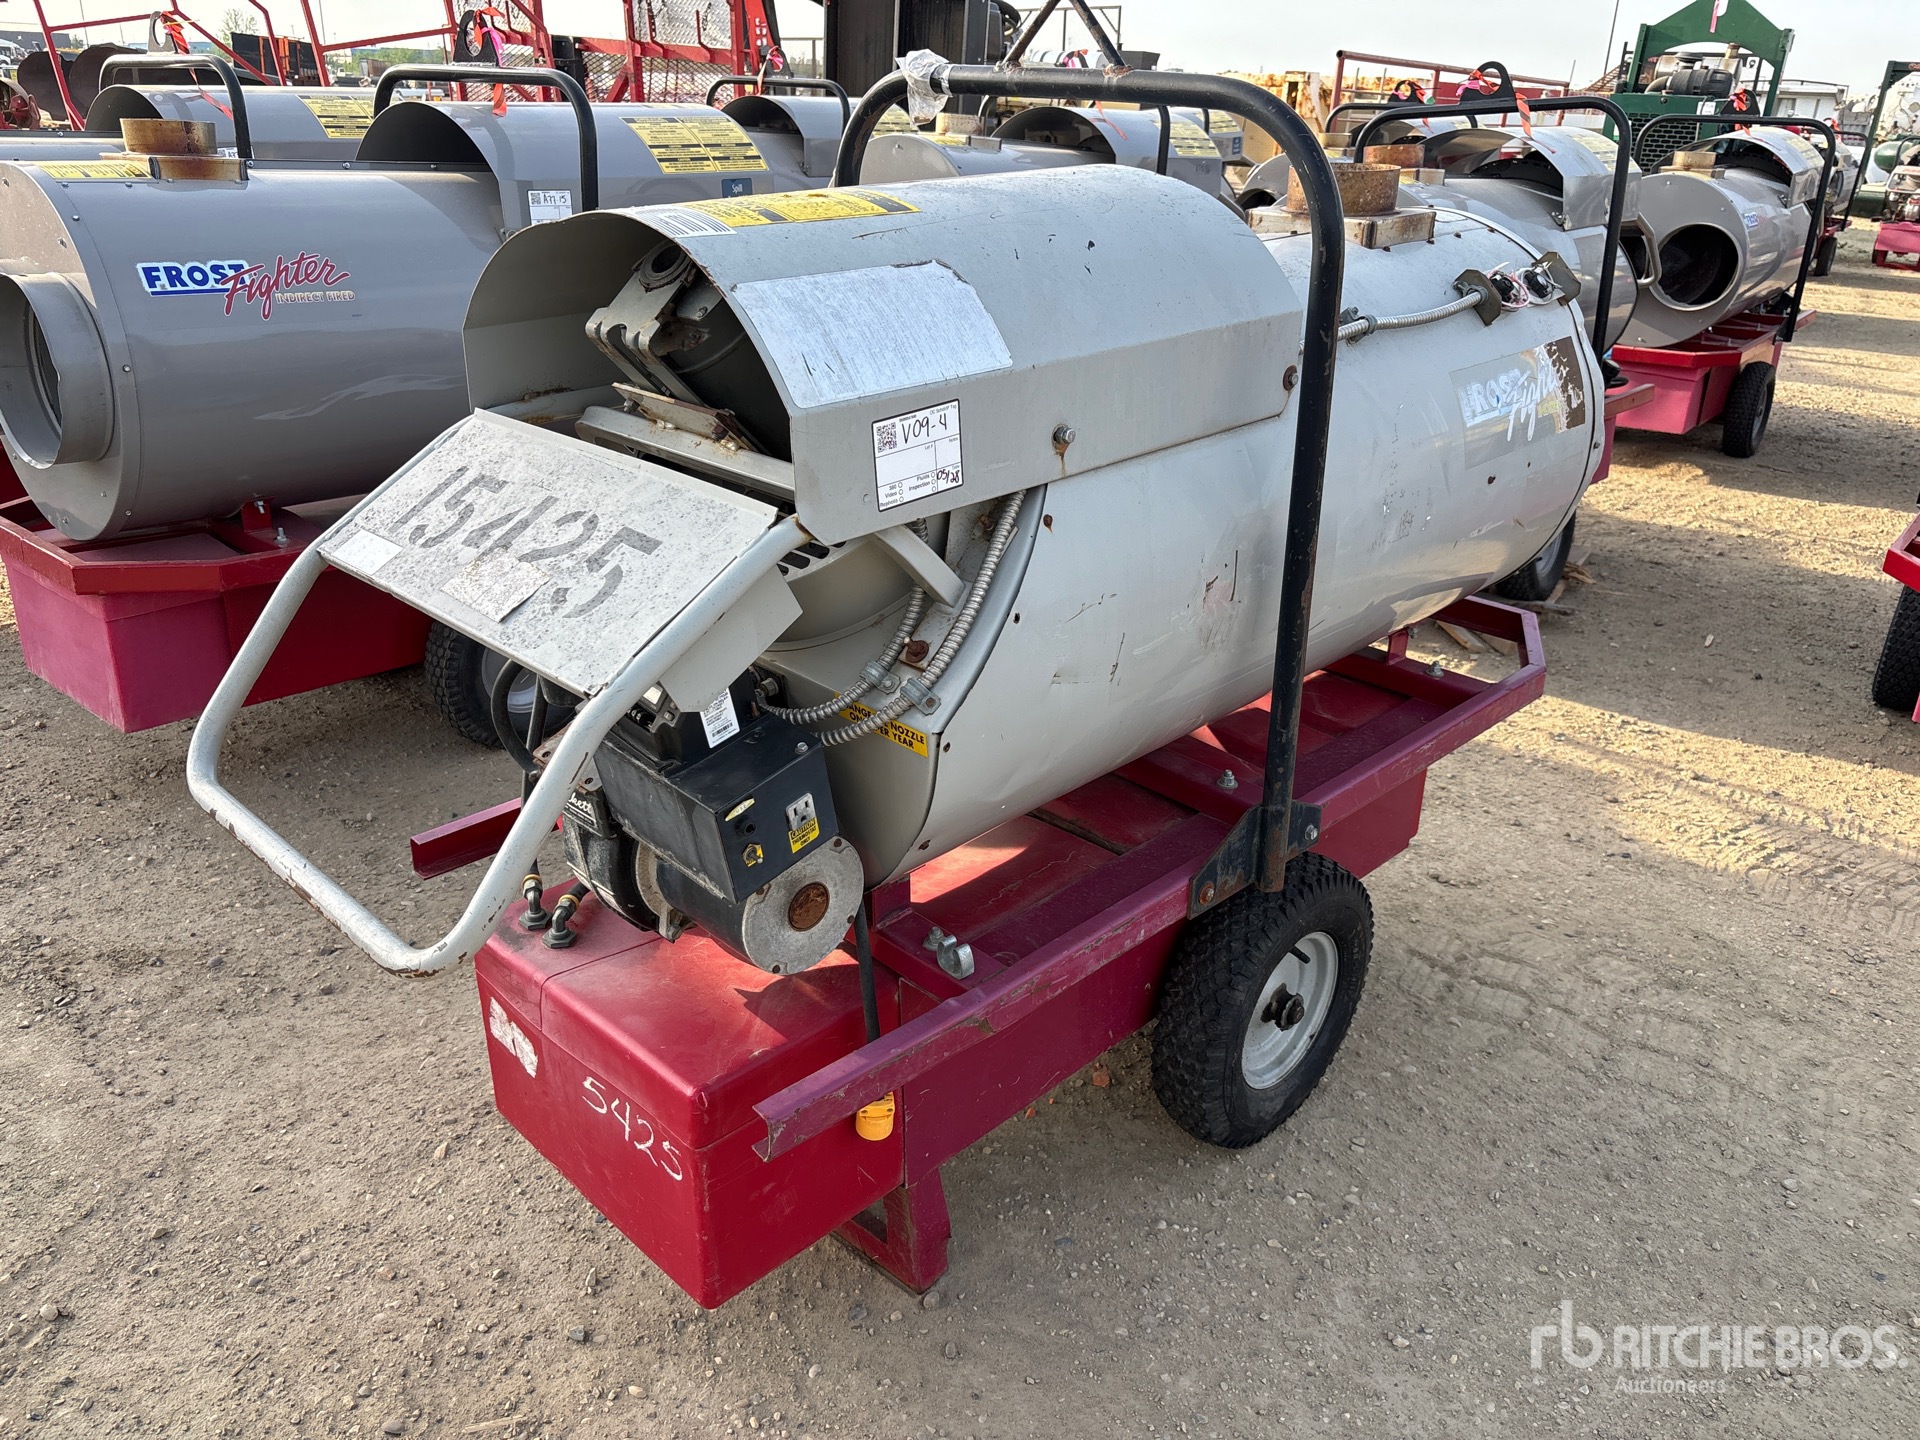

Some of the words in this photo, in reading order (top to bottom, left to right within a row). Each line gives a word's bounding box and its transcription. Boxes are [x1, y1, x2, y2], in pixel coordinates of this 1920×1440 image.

[731, 183, 743, 194] Spill
[141, 262, 248, 290] FROST
[219, 251, 351, 320] Fighter
[275, 292, 325, 304] INDIRECT
[326, 290, 356, 302] FIRED
[901, 412, 947, 444] V09-4
[917, 473, 930, 481] Fluids
[936, 468, 960, 484] 05/28
[884, 491, 898, 499] Video
[908, 481, 930, 491] Inspection
[388, 465, 663, 619] 15425
[890, 721, 925, 745] NOZZLE
[892, 731, 915, 749] YEAR
[791, 819, 816, 838] CAUTION
[792, 826, 817, 846] THERMOSTAT
[800, 836, 811, 846] ONLY
[582, 1076, 683, 1181] 5425
